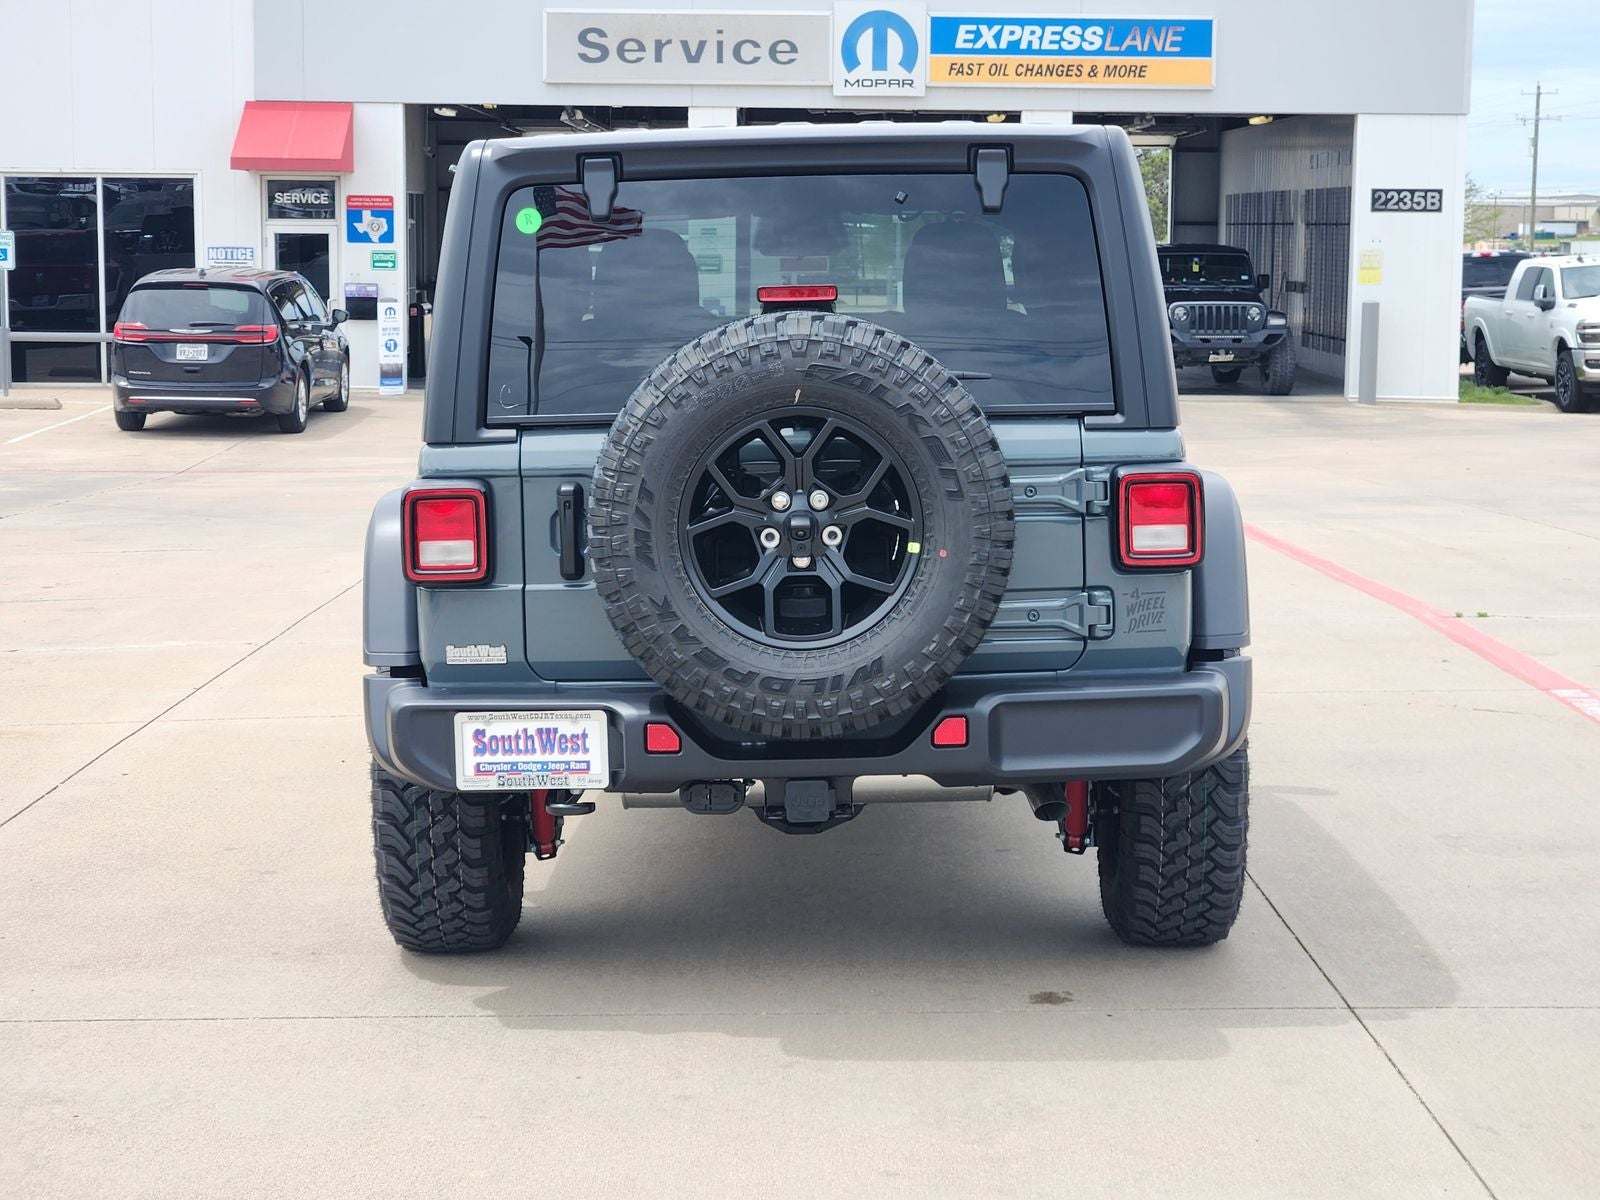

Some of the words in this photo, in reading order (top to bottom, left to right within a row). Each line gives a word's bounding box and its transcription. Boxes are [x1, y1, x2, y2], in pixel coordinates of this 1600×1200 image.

[577, 27, 799, 65] Service
[949, 63, 985, 77] FAST
[989, 64, 1009, 77] OIL
[1015, 64, 1083, 78] CHANGES
[1087, 65, 1099, 78] &
[1104, 65, 1148, 78] MORE
[844, 78, 915, 88] MOPAR
[274, 192, 329, 204] SERVICE
[1373, 190, 1441, 210] 2235B
[208, 247, 253, 260] NOTICE
[1130, 587, 1140, 600] 4
[1126, 596, 1166, 617] WHEEL
[1127, 611, 1165, 634] DRIVE
[472, 727, 590, 757] SouthWest
[479, 763, 511, 773] Chrysler
[518, 763, 542, 772] Dodge
[547, 762, 565, 772] Jeep
[569, 762, 587, 770] Ram
[497, 775, 570, 787] SouthWest
